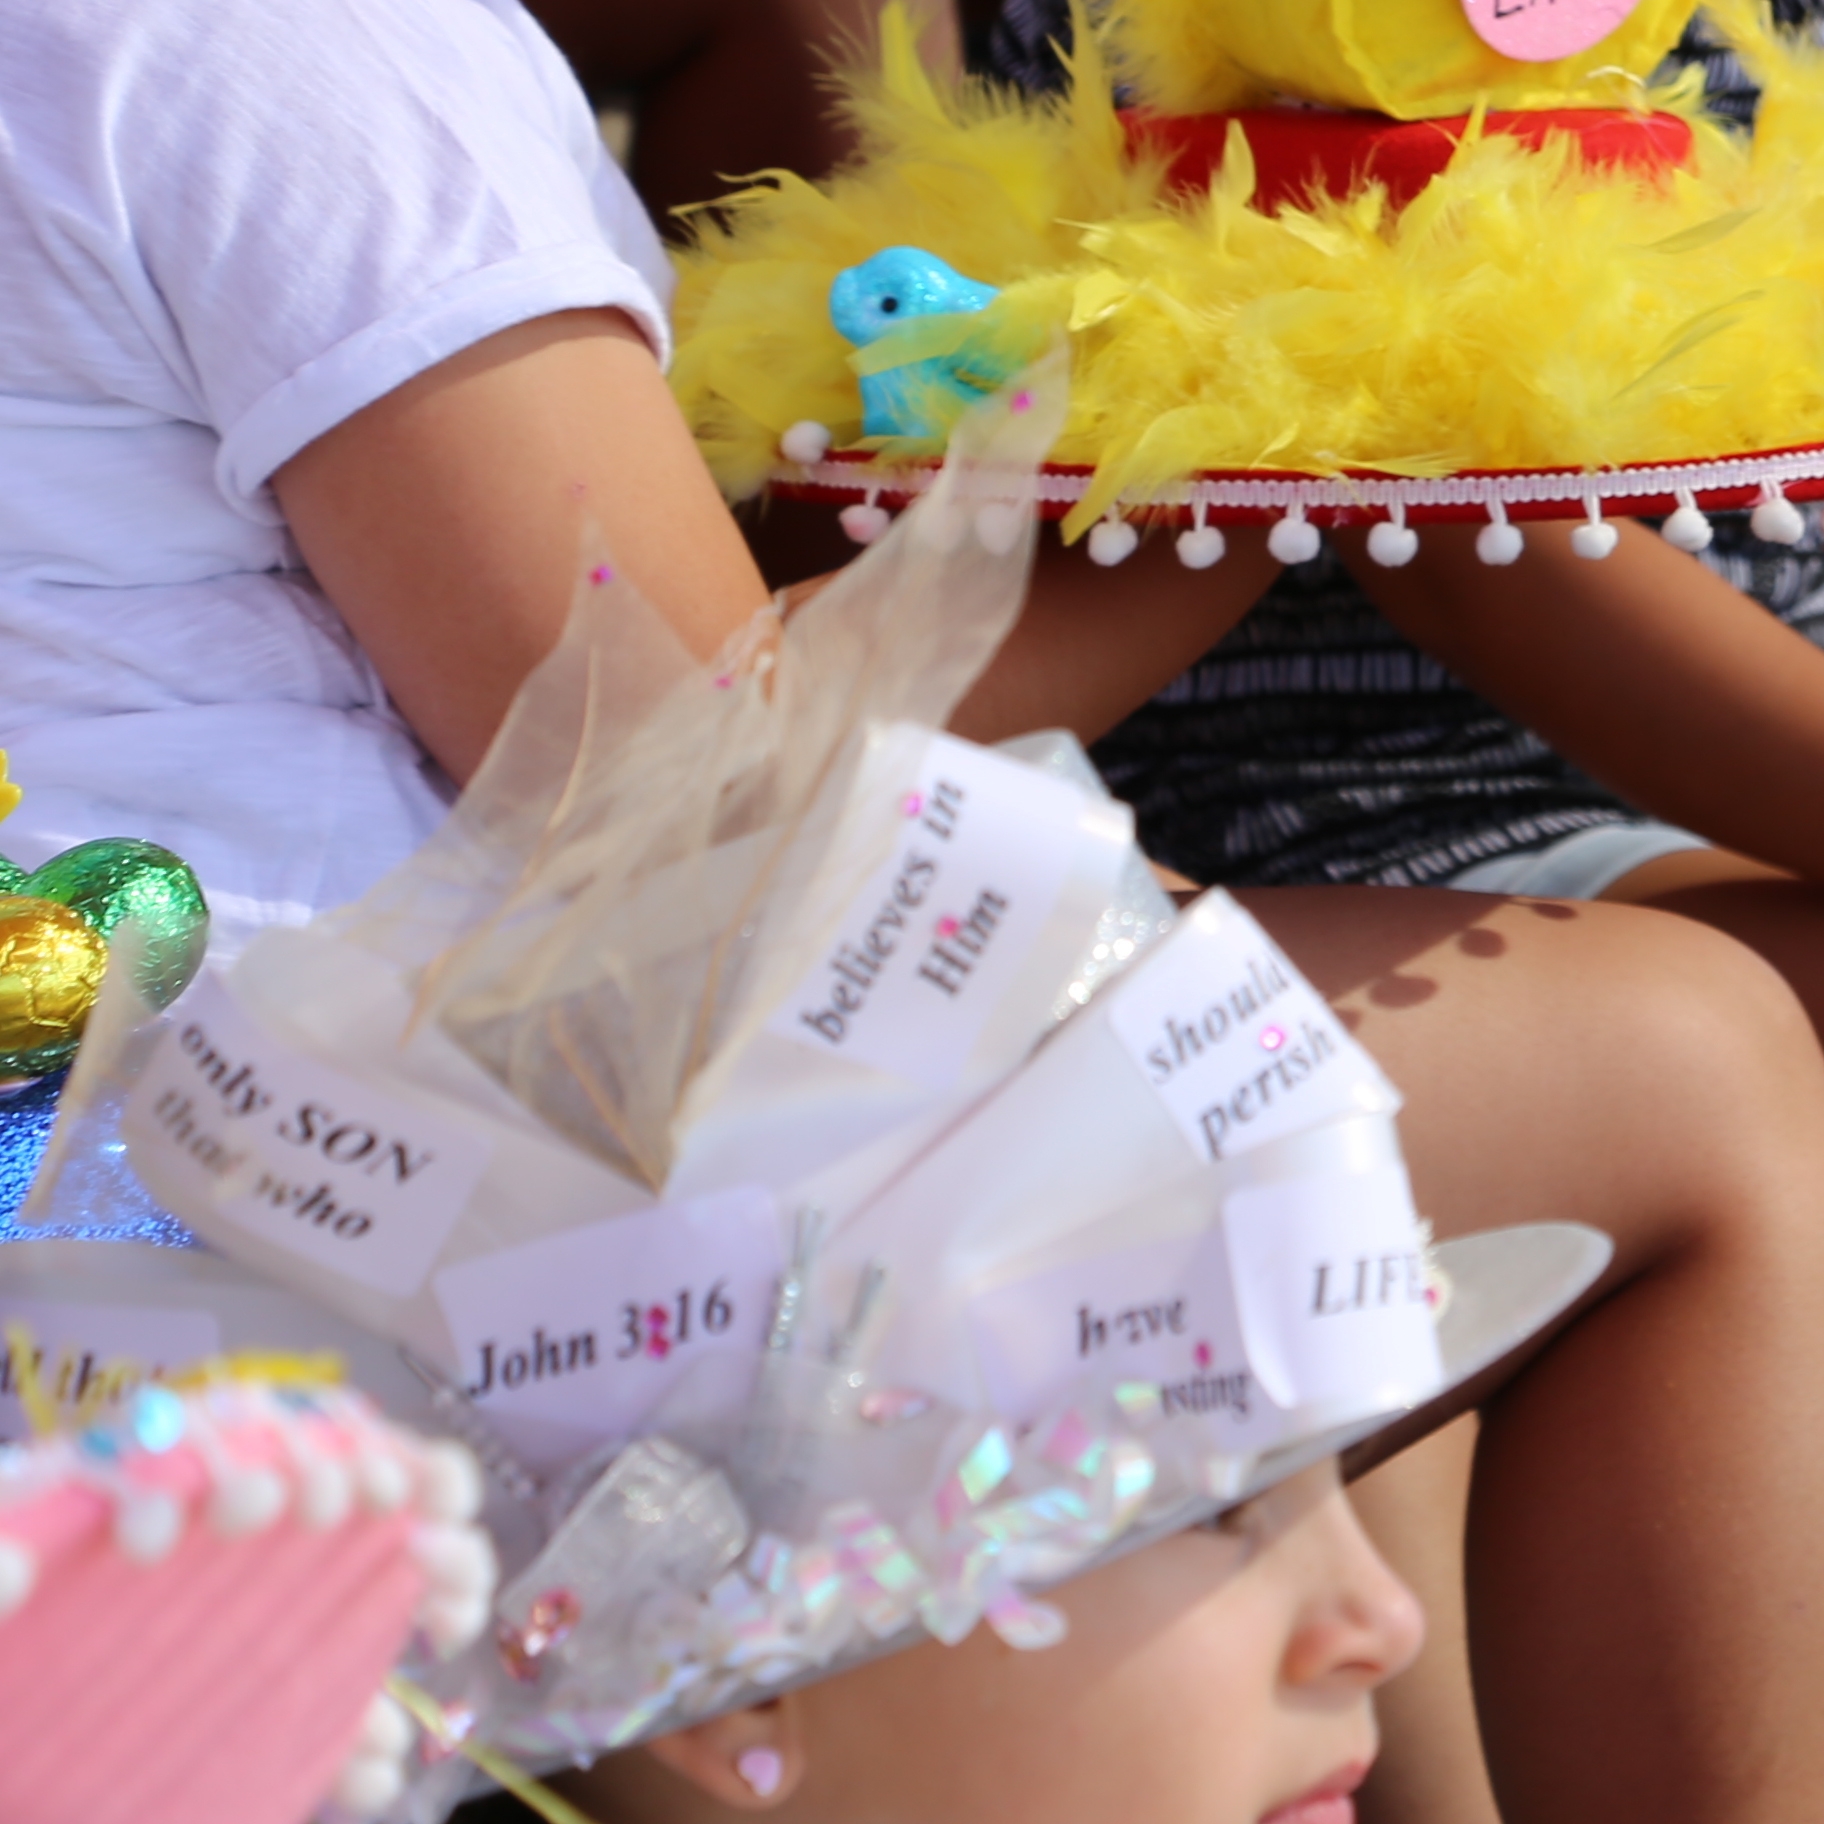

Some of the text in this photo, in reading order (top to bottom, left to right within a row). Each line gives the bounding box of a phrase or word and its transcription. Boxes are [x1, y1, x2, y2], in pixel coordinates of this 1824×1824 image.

[801, 848, 938, 1045] believes
[1146, 952, 1289, 1083] should
[180, 1024, 436, 1186] only SON
[1198, 1021, 1336, 1163] perish
[256, 1174, 374, 1242] who
[1310, 1254, 1426, 1314] LIFE
[468, 1326, 598, 1400] John
